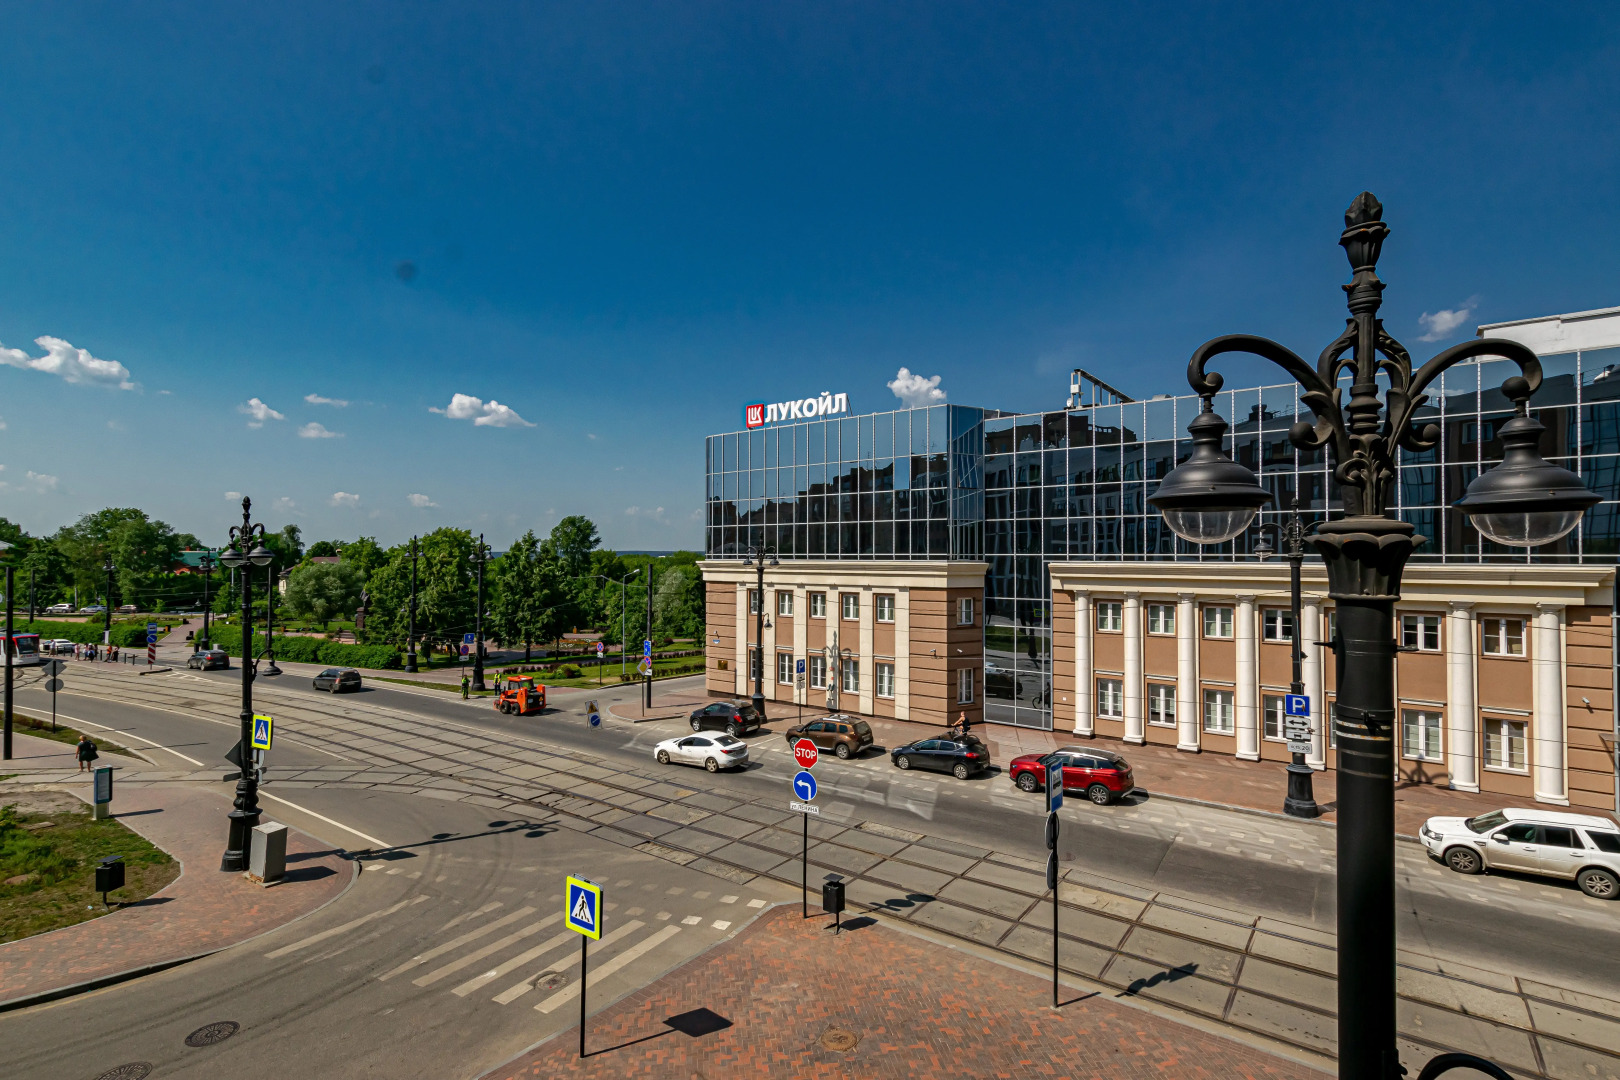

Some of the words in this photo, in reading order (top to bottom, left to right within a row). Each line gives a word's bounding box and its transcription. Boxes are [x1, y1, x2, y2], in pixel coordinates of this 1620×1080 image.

[765, 391, 847, 422] ЛУКОЙЛ
[1292, 697, 1306, 713] P
[796, 747, 817, 759] STOP
